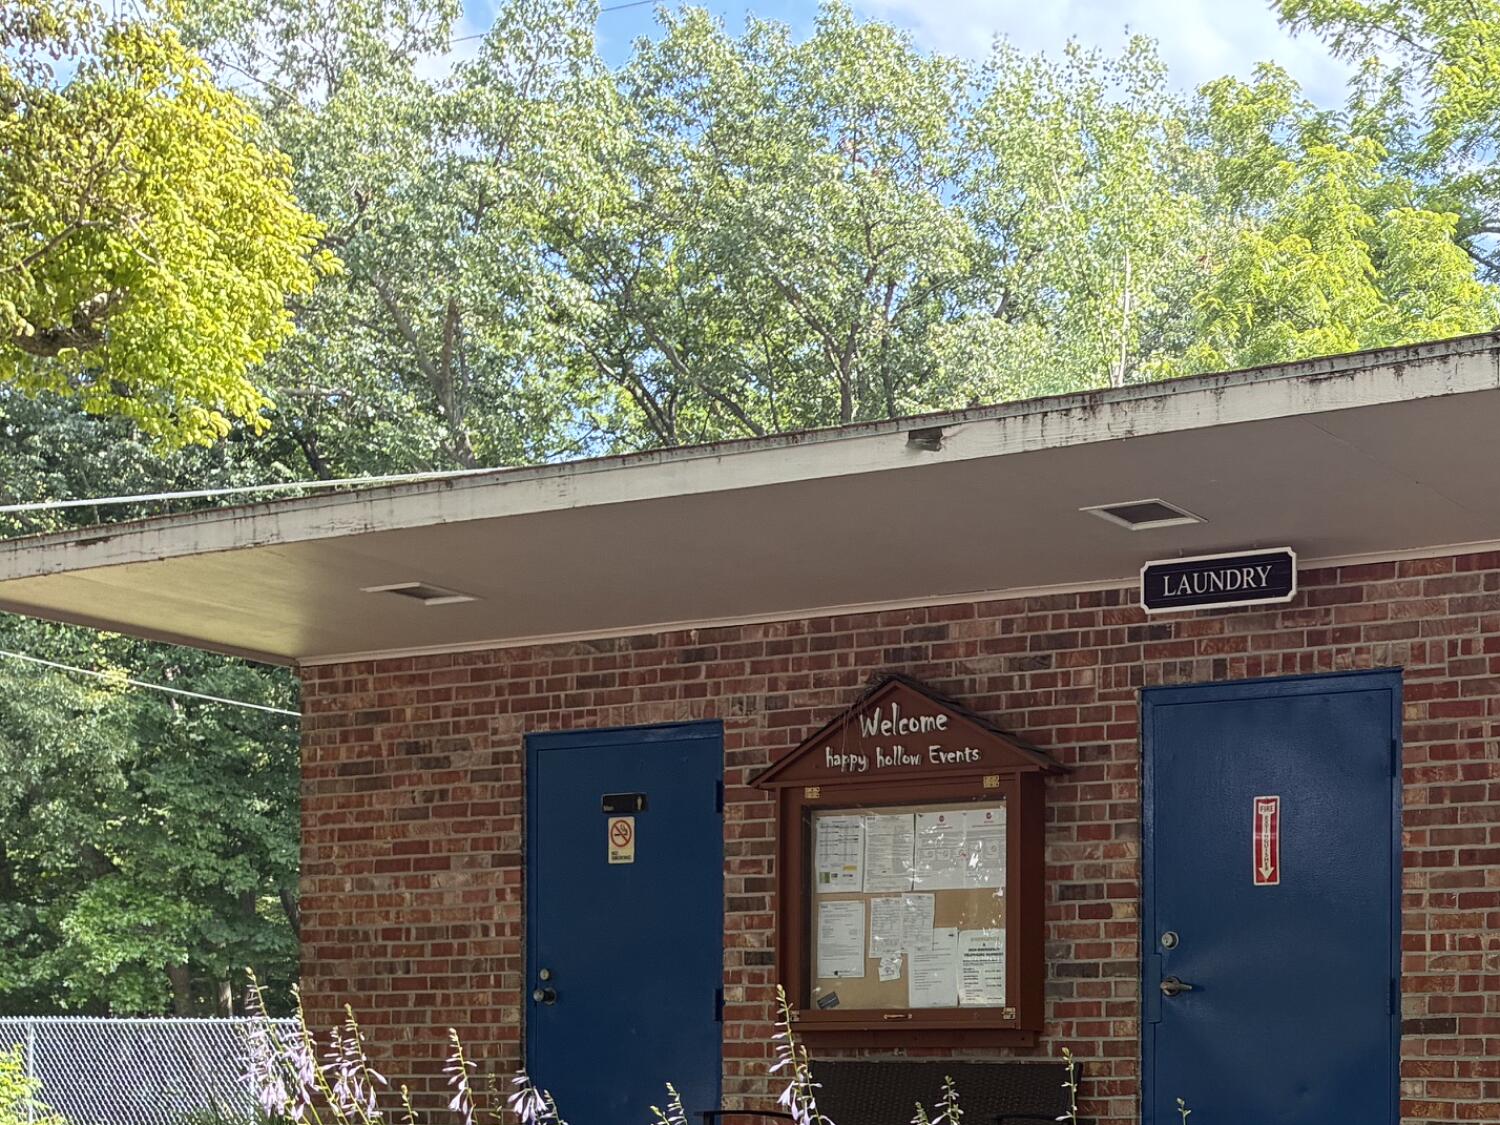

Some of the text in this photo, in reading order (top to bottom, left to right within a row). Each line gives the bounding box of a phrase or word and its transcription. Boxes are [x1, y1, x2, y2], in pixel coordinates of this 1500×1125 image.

[1162, 565, 1273, 597] LAUNDRY
[859, 702, 948, 738] Welcome
[825, 744, 980, 773] happy hollow Events
[1260, 804, 1274, 812] FIRE
